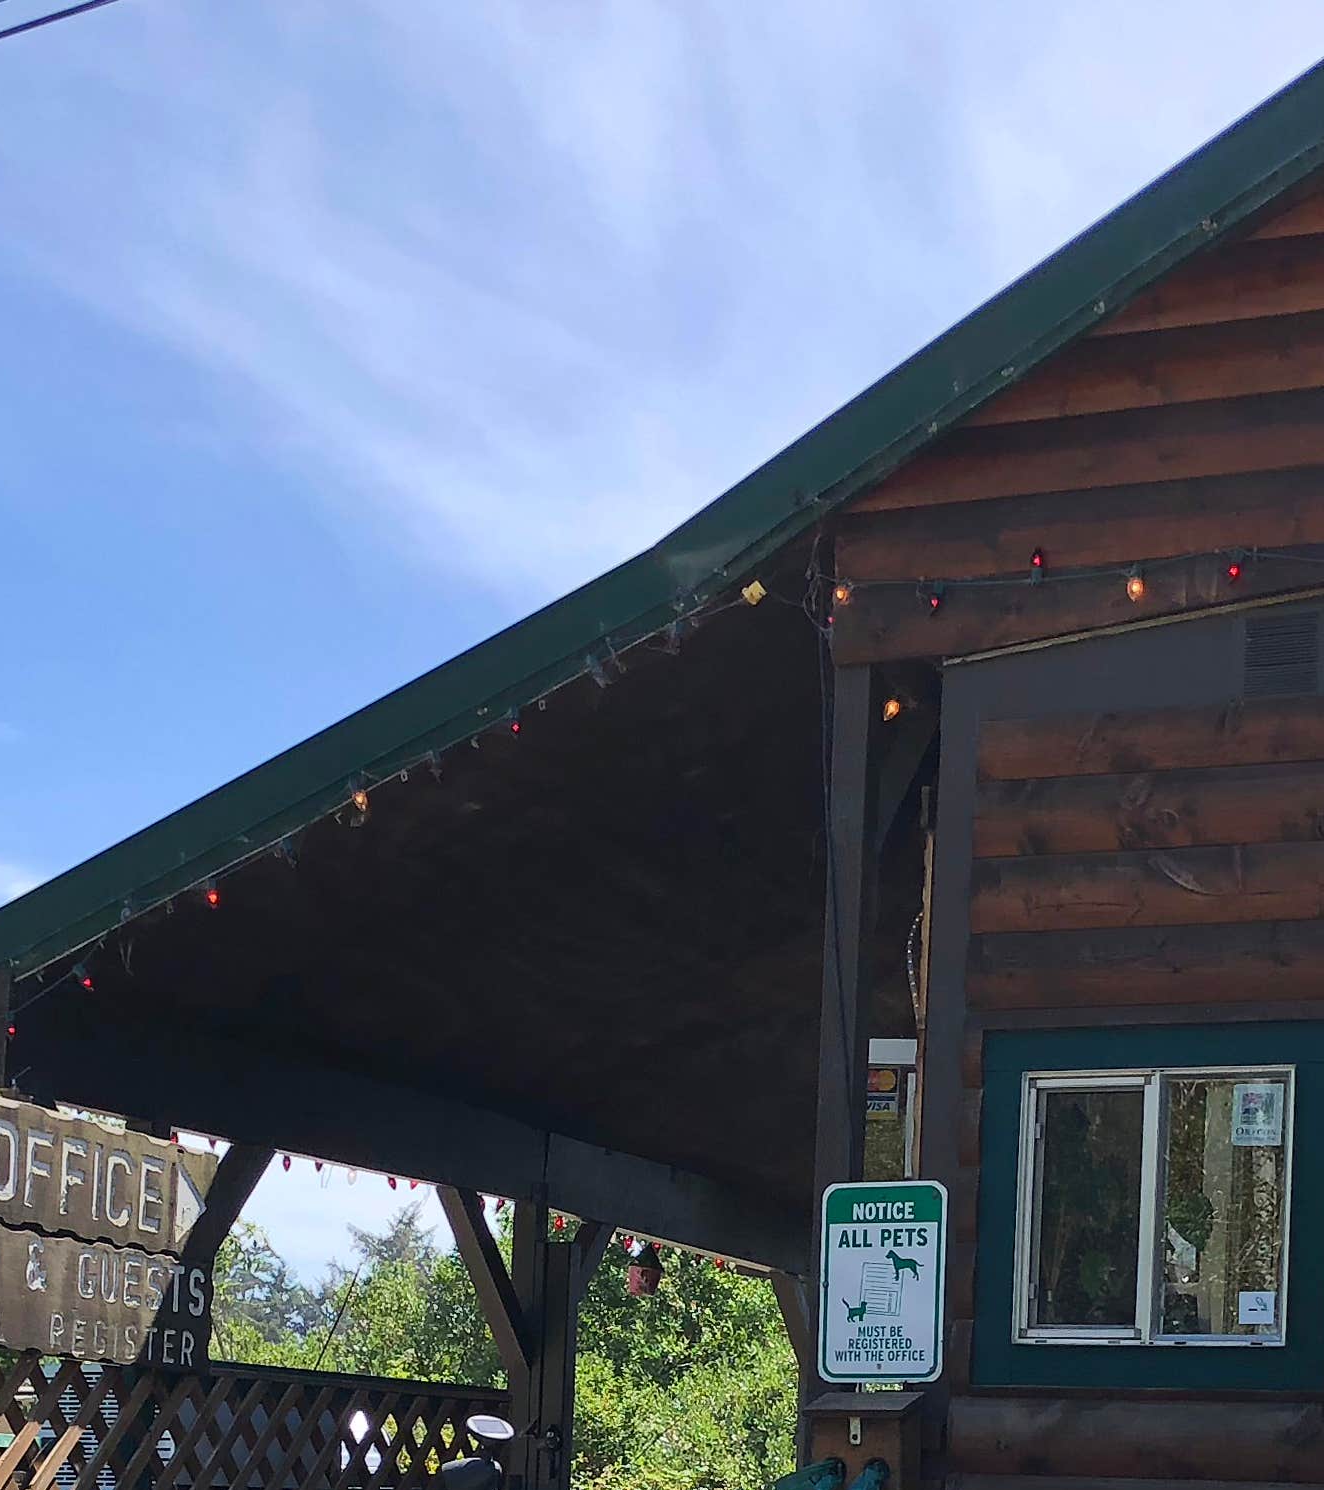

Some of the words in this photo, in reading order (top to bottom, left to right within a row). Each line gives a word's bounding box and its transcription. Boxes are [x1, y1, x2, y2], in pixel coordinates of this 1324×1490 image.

[852, 1201, 915, 1221] NOTICE
[838, 1229, 872, 1248] ALL
[880, 1228, 928, 1247] PETS
[25, 1237, 48, 1293] &
[77, 1246, 206, 1318] GUESTS
[49, 1312, 194, 1368] REGISTER
[857, 1326, 885, 1338] MUST
[889, 1326, 903, 1337] BE
[847, 1338, 912, 1350] REGISTERED
[835, 1351, 861, 1362] WITH
[865, 1350, 884, 1362] THE
[888, 1350, 925, 1362] OFFICE
